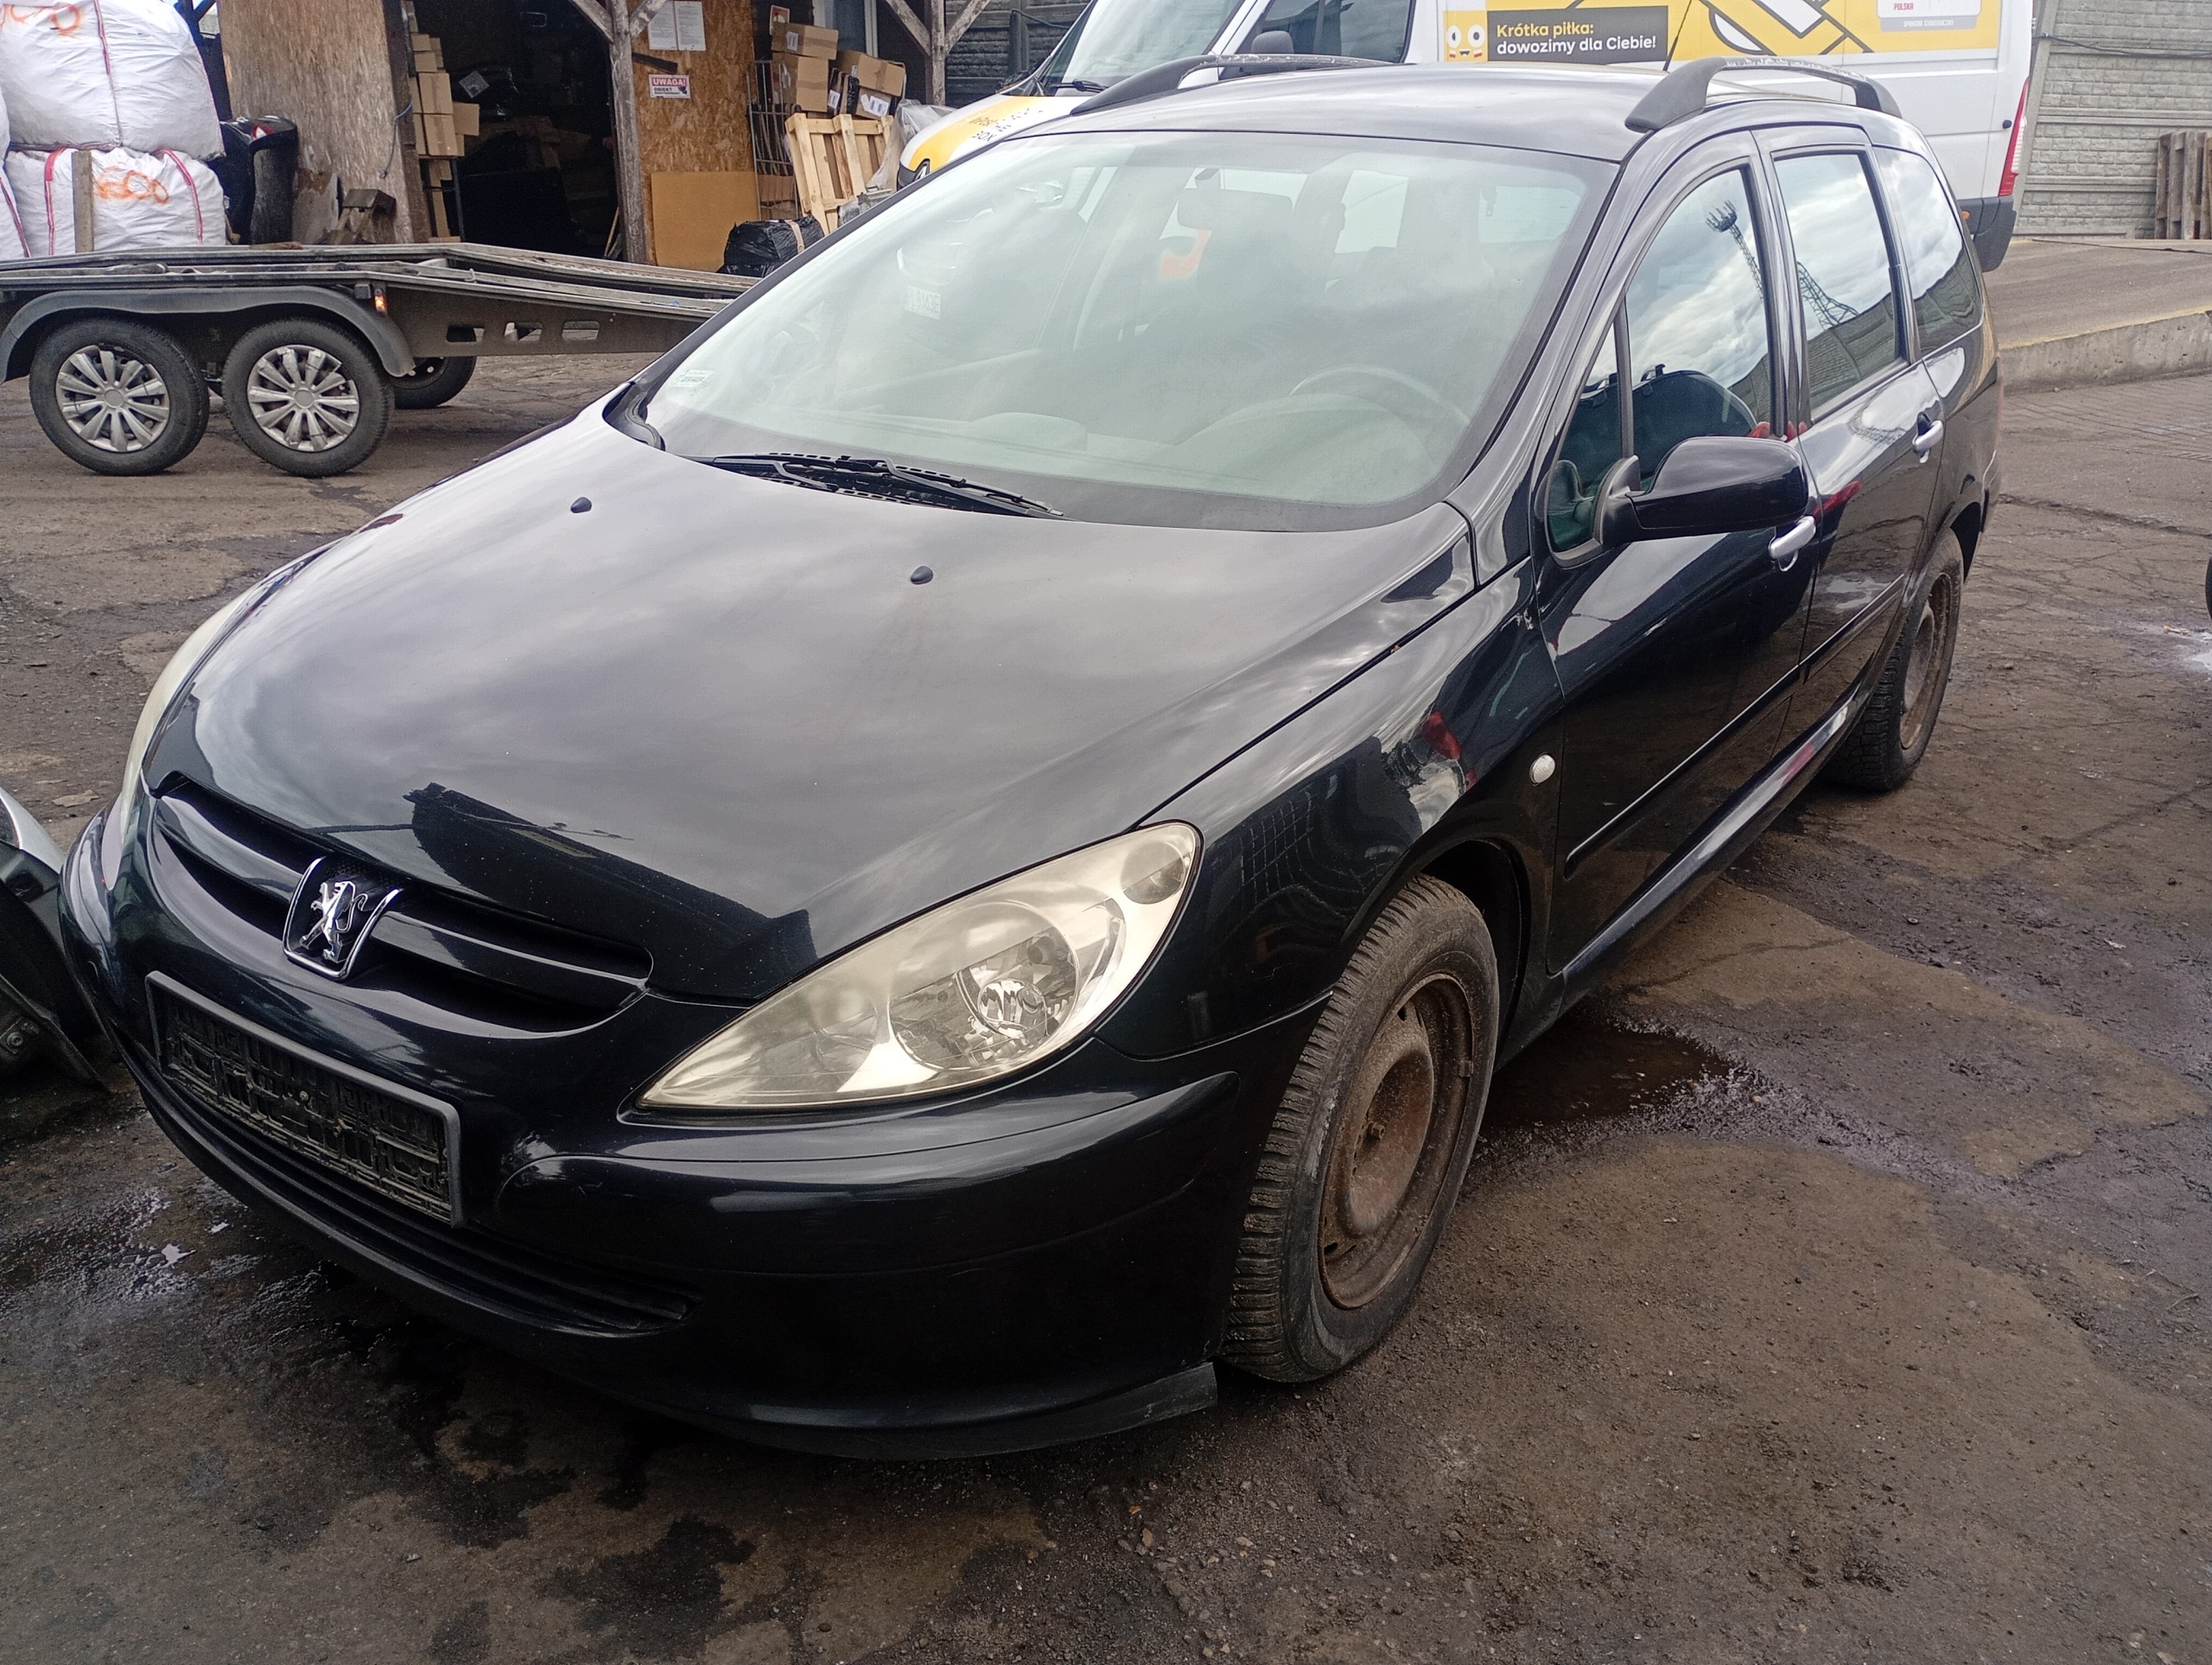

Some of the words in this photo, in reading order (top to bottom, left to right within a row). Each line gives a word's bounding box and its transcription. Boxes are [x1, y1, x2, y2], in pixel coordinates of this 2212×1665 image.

[1497, 23, 1549, 37] Krótka
[1553, 22, 1594, 38] piłka:
[1497, 39, 1575, 54] dowozimy
[1579, 38, 1603, 51] dla
[1606, 35, 1656, 49] Ciebie!
